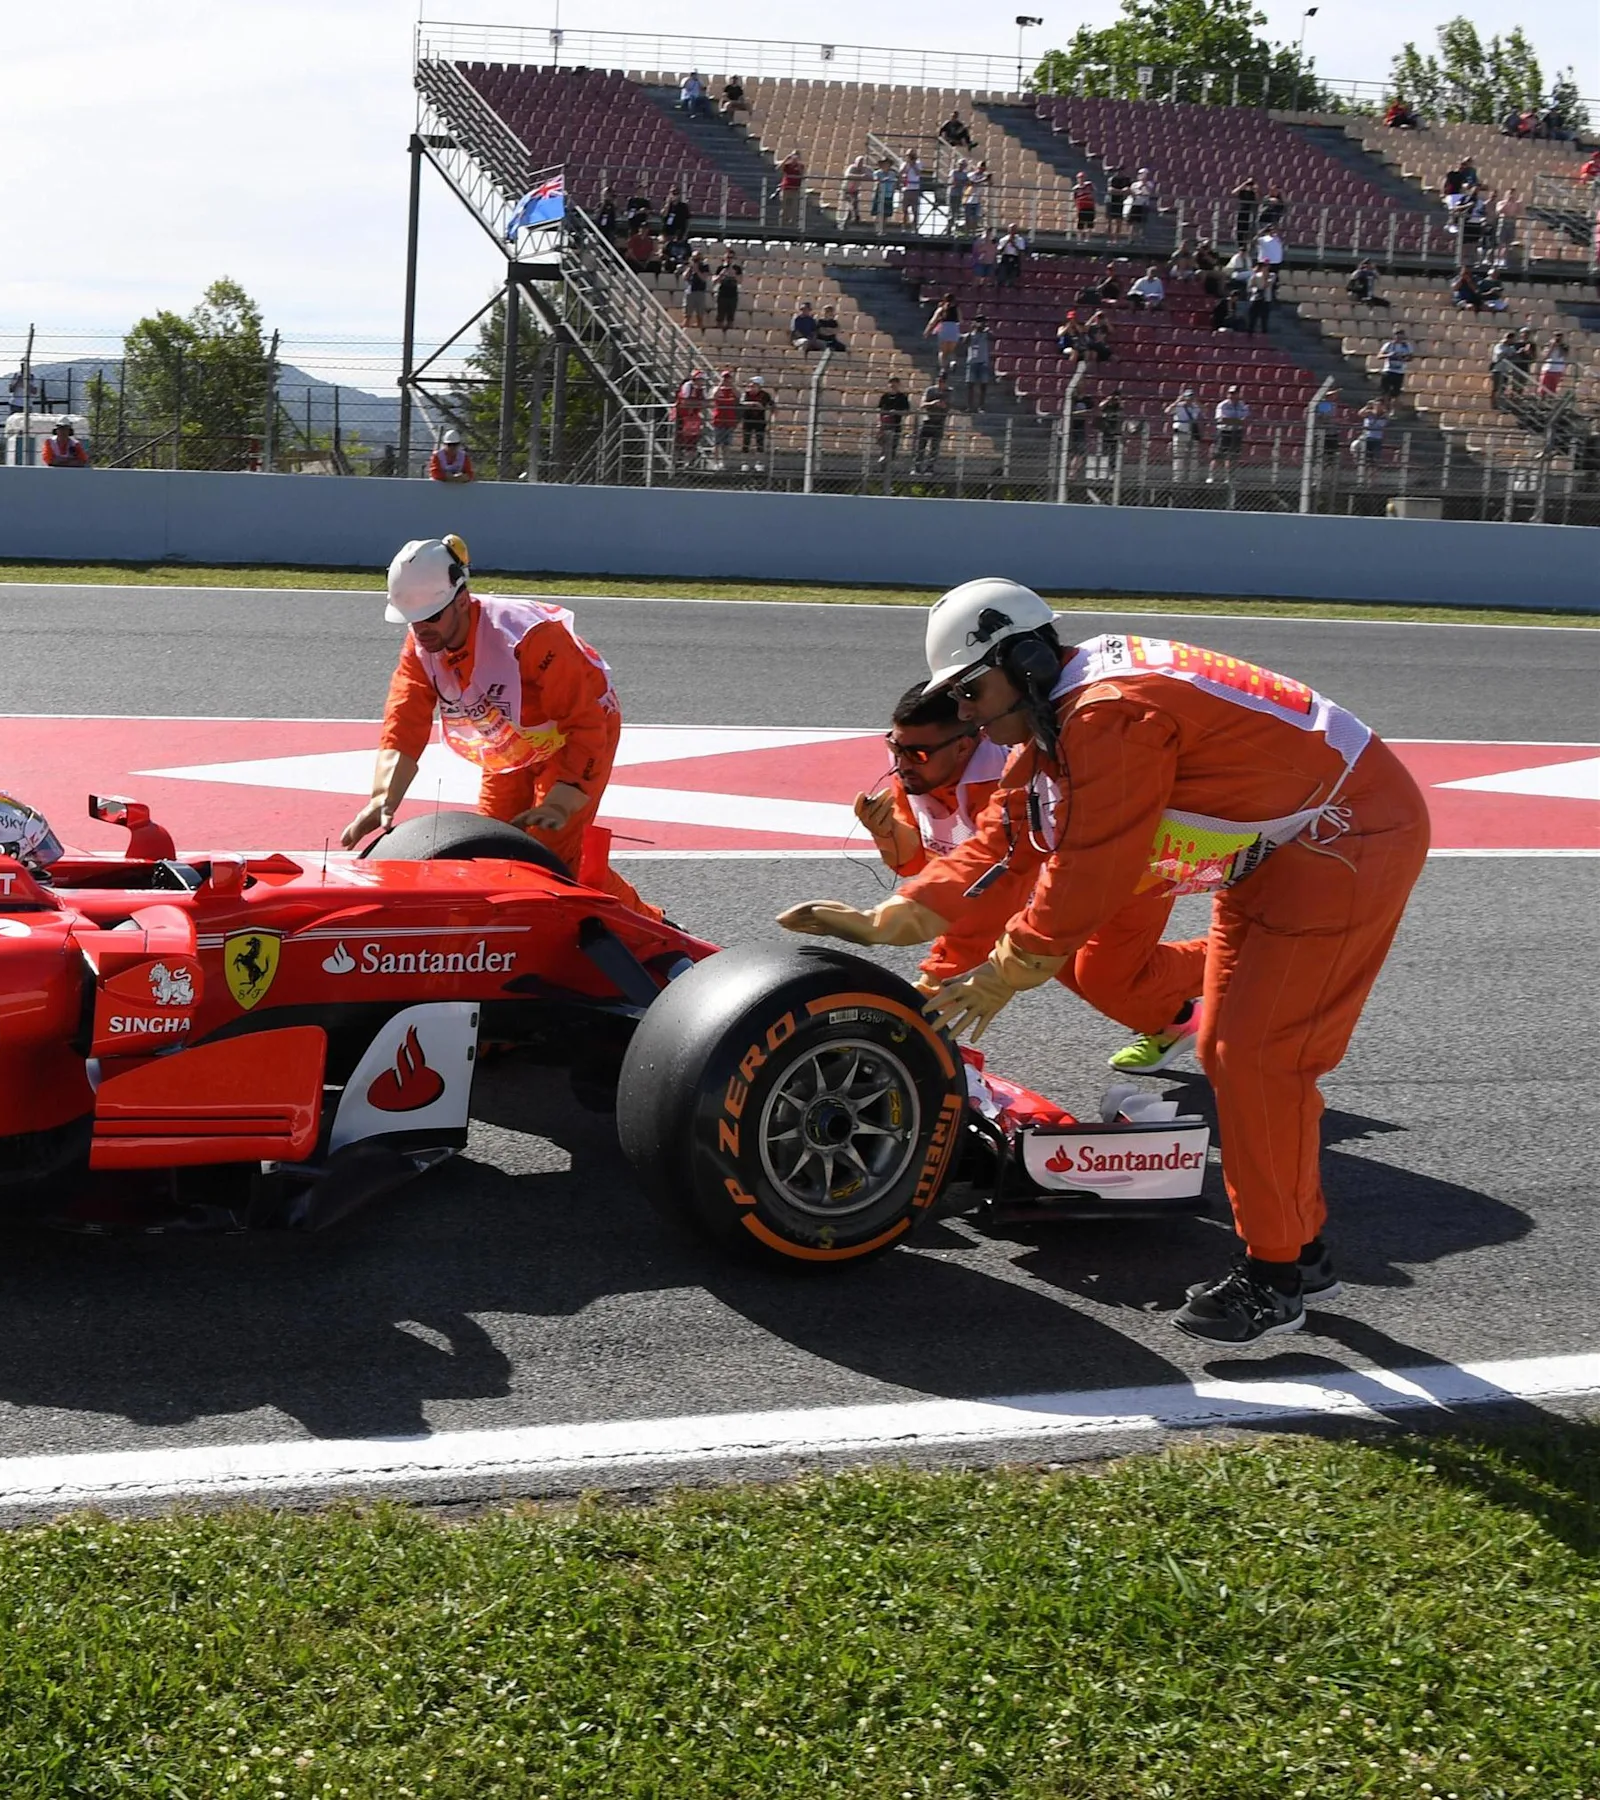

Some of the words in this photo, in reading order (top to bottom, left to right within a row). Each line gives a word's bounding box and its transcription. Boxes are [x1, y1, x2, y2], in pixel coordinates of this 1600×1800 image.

[360, 940, 516, 973] Santander
[108, 1016, 191, 1034] SINGHA
[718, 1011, 796, 1158] ZERO
[912, 1094, 963, 1208] PIRELLI
[1076, 1143, 1203, 1172] Santander
[723, 1178, 757, 1205] P
